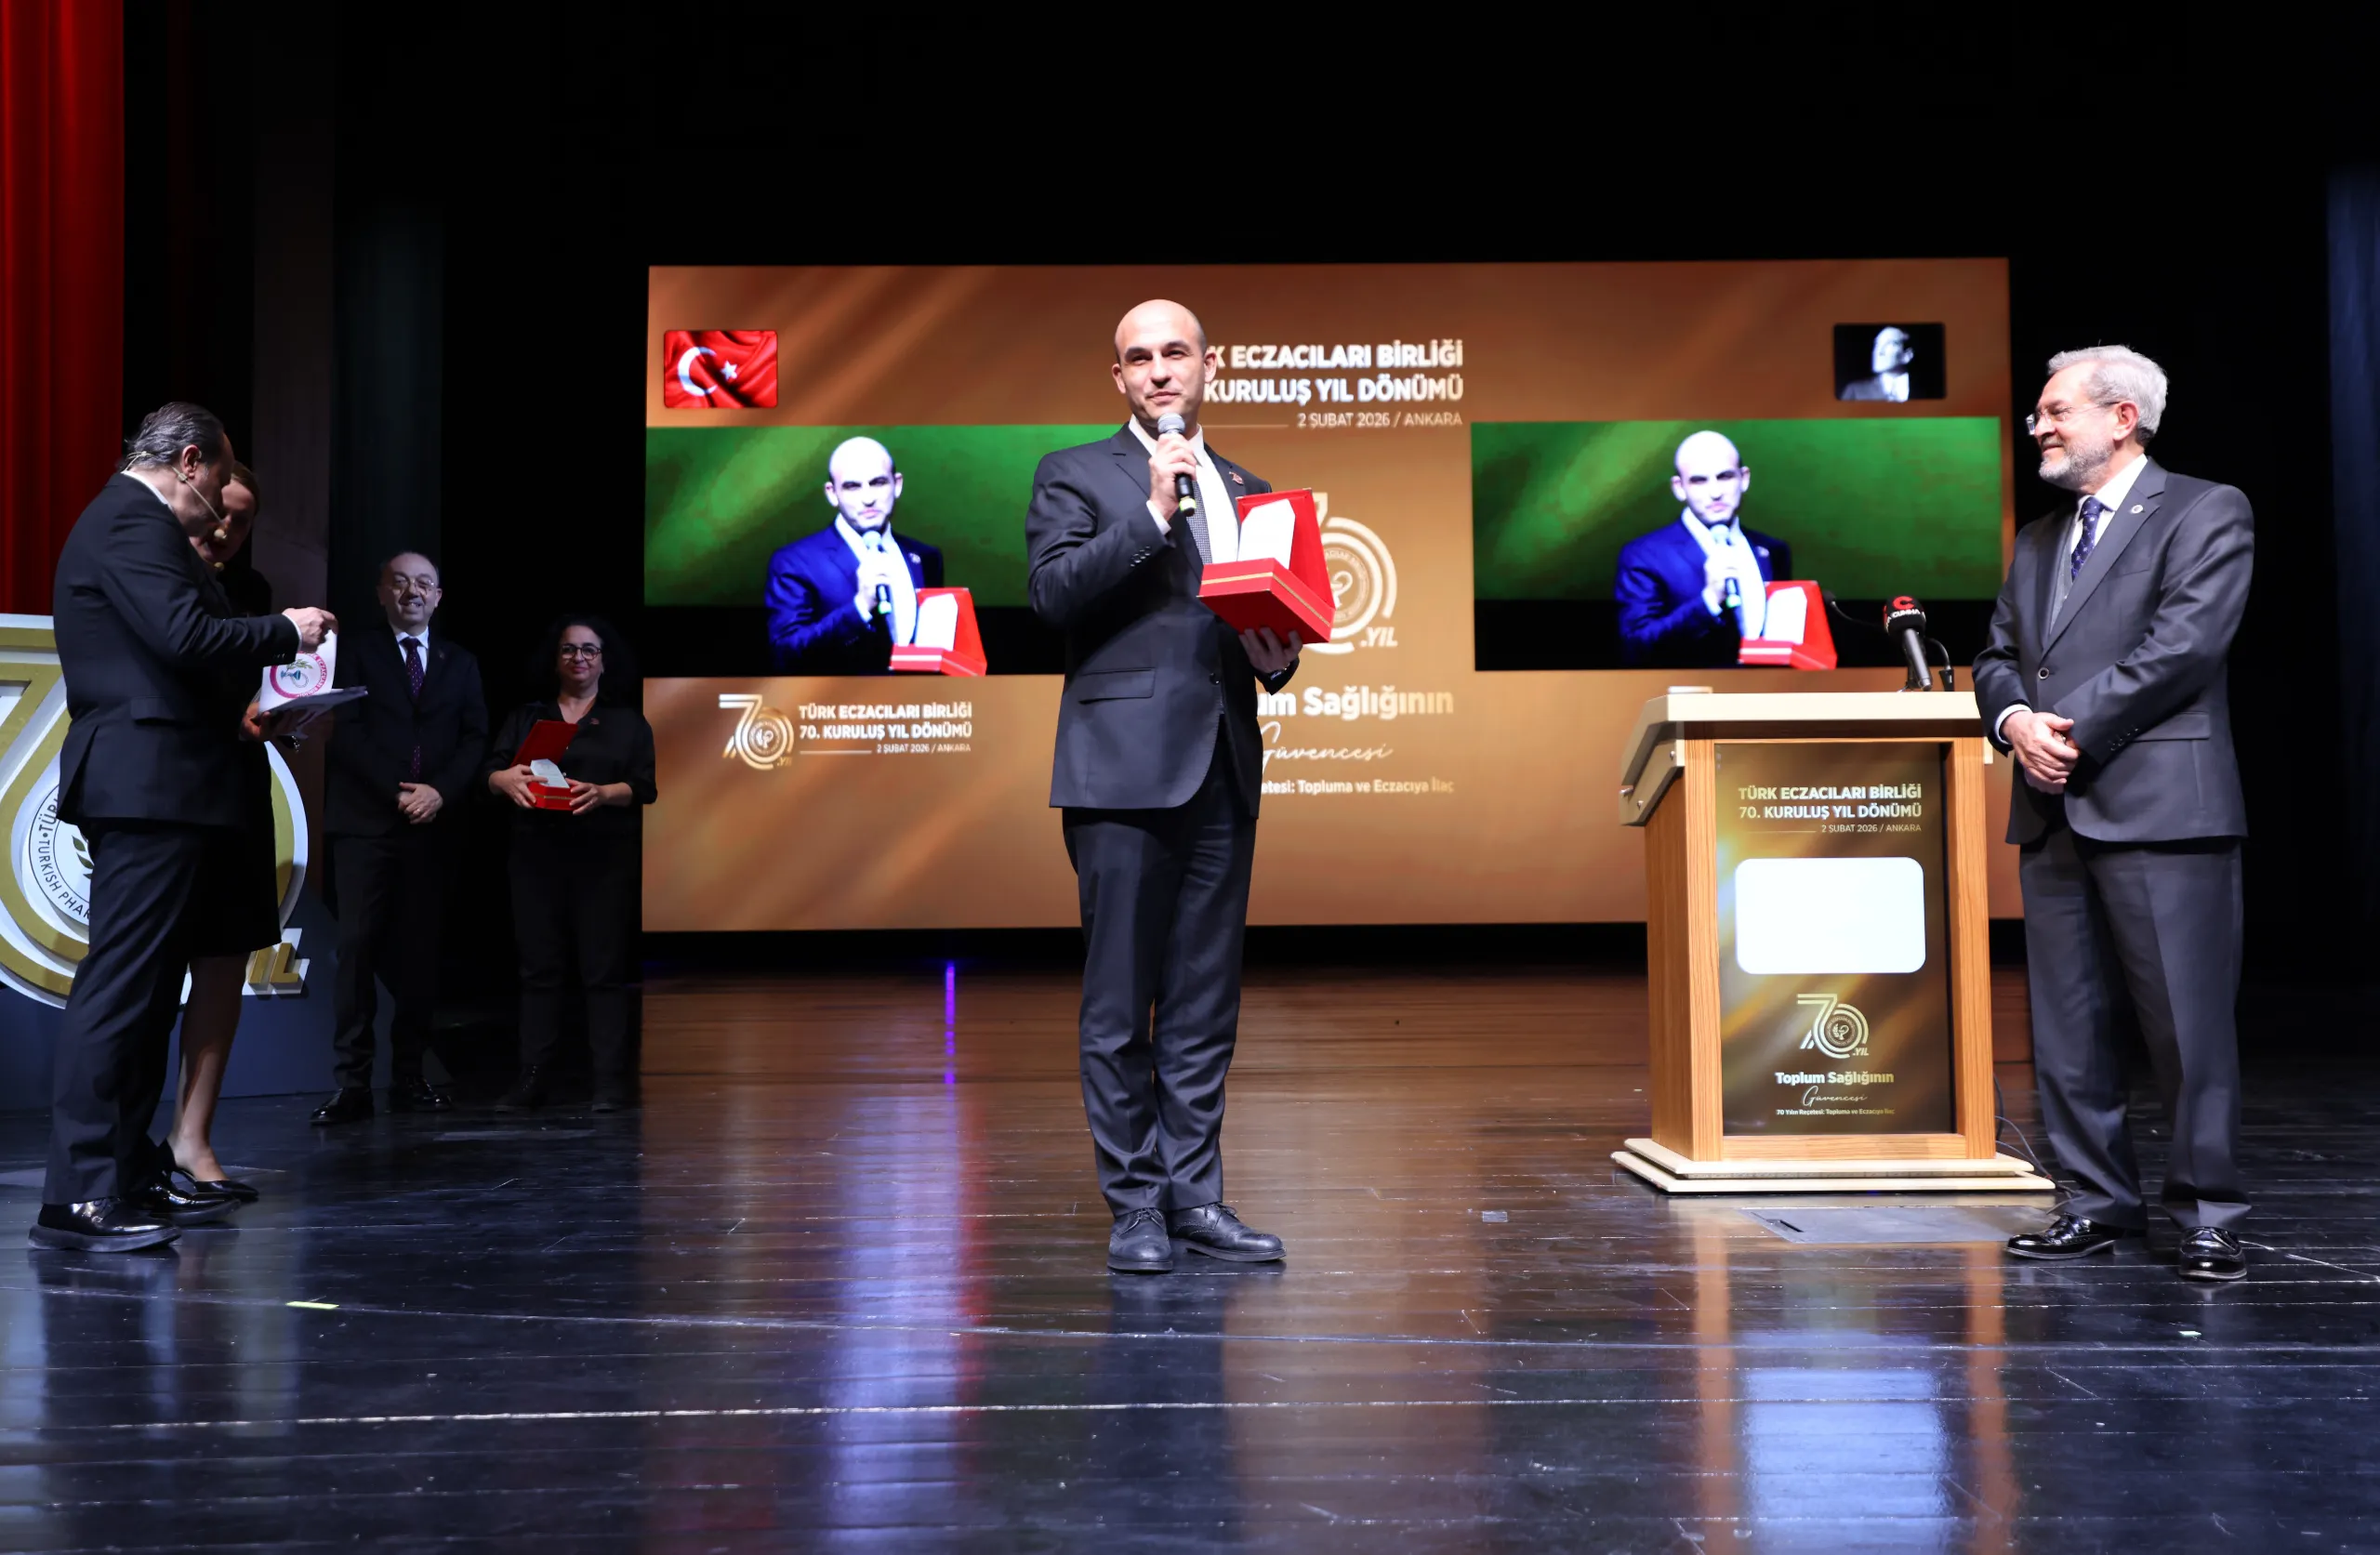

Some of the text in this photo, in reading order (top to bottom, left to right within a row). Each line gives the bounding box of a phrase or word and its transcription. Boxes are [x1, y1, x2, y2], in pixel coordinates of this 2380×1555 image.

[1231, 345, 1371, 369] ECZACILARI
[1377, 339, 1463, 368] BİRLİĞİ
[1204, 373, 1464, 406] KURULUŞ YIL DÖNÜMÜ
[1298, 412, 1463, 429] 2 ŞUBAT 2026 / ANKARA
[1359, 626, 1398, 648] .YIL
[799, 701, 972, 720] TÜRK ECZACILARI BİRLİĞİ
[1303, 684, 1454, 720] Sağlığının
[800, 724, 821, 740] 70.
[824, 723, 885, 742] KURULUŞ
[888, 723, 909, 739] YIL
[911, 721, 972, 739] DÖNÜMÜ
[877, 744, 882, 754] 2
[883, 744, 908, 755] ŞUBAT
[910, 744, 930, 754] 2026
[937, 743, 972, 753] ANKARA
[1261, 776, 1455, 796] etesi: Topluma ve Eczacıya İlaç
[1739, 784, 1922, 800] TÜRK ECZACILARI BİRLİĞİ
[1739, 802, 1922, 820] 70. KURULUŞ YIL DÖNÜMÜ
[1821, 824, 1827, 833] 2
[1828, 824, 1855, 834] ŞUBAT
[1858, 824, 1878, 833] 2026
[1885, 824, 1922, 833] ANKARA
[38, 839, 62, 892] TURKISH
[1775, 1070, 1895, 1087] Toplum Sağlığının
